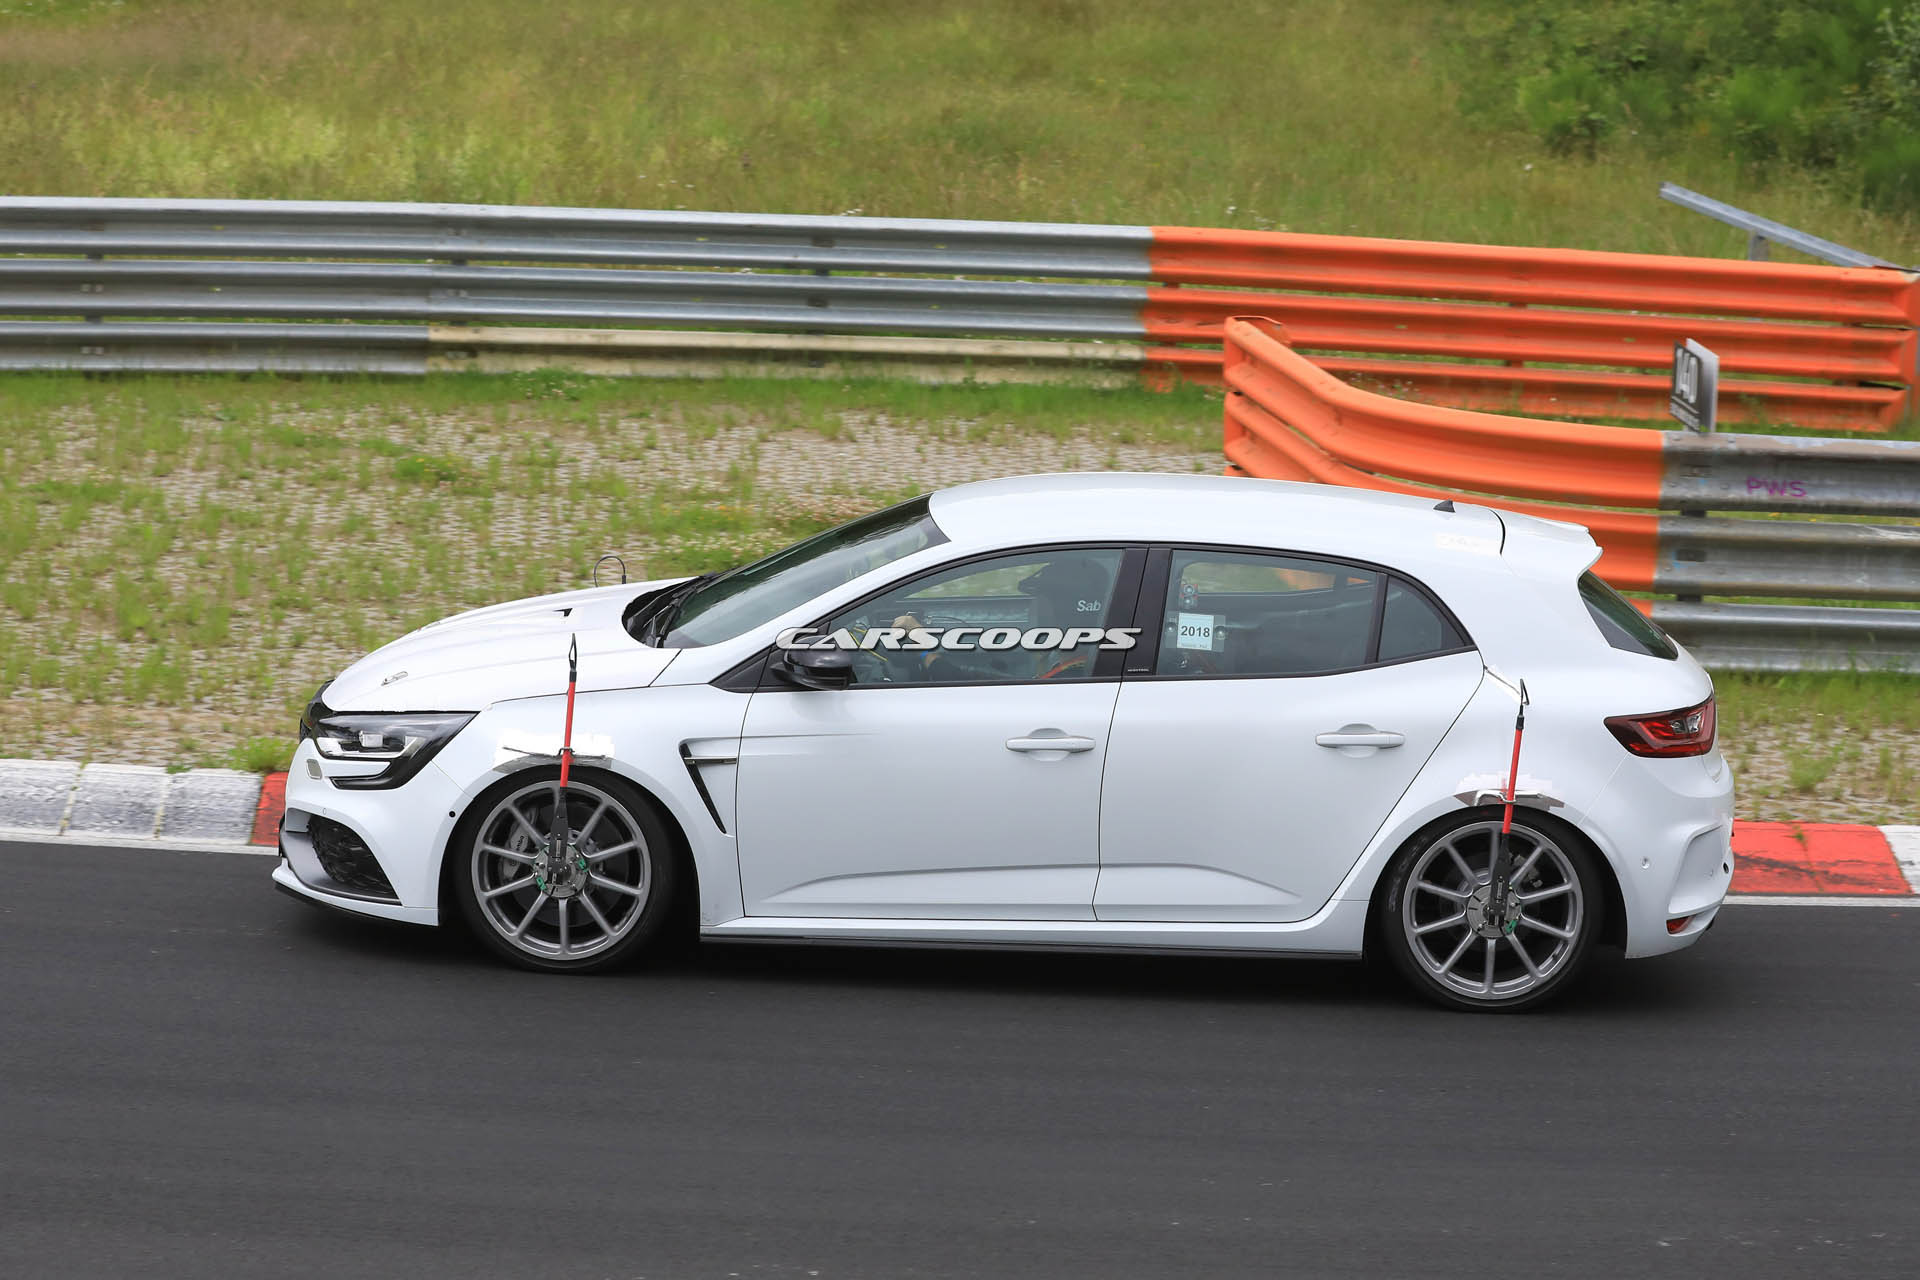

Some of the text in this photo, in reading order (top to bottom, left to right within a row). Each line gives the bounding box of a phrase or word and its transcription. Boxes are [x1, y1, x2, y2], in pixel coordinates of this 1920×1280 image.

[1745, 476, 1808, 498] PWS
[1076, 599, 1102, 613] Sab
[1180, 625, 1211, 638] 2018
